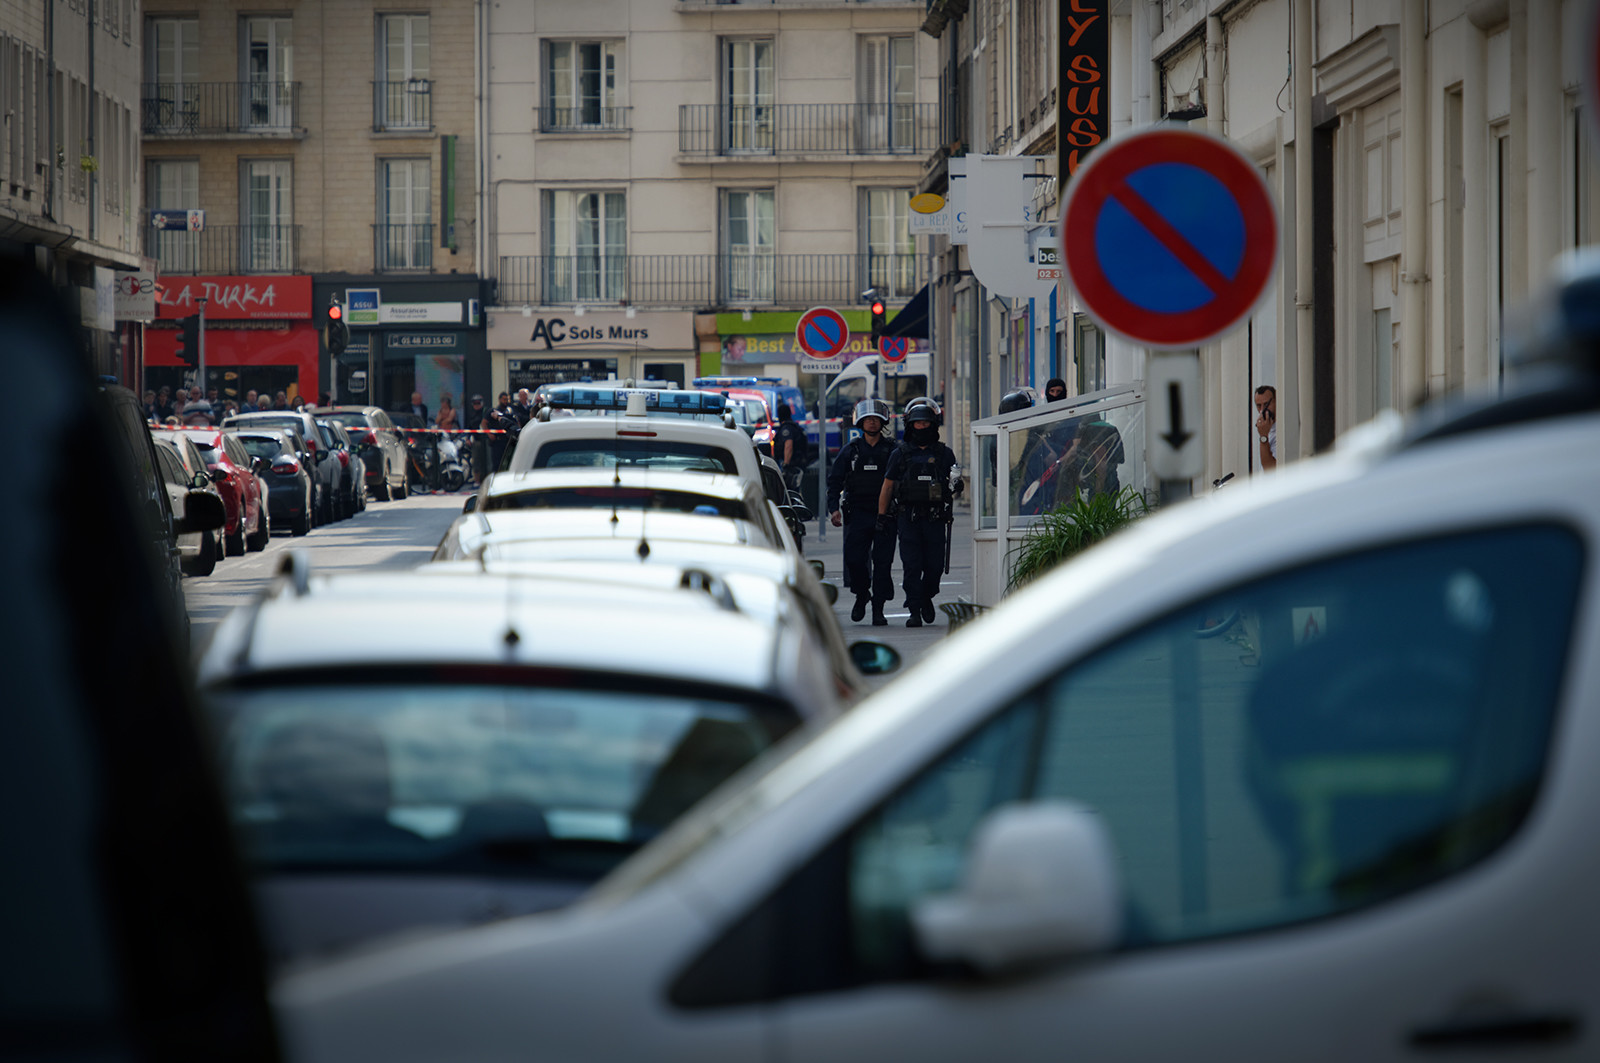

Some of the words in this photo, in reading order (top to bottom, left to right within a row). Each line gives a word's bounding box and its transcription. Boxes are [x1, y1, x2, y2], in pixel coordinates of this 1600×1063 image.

[1039, 270, 1051, 278] 02
[161, 284, 192, 308] LA
[202, 282, 276, 311] TURKA
[390, 306, 427, 314] Assurances
[530, 318, 566, 349] AC
[569, 326, 603, 339] Sols
[609, 326, 649, 339] Murs
[745, 337, 785, 353] Best
